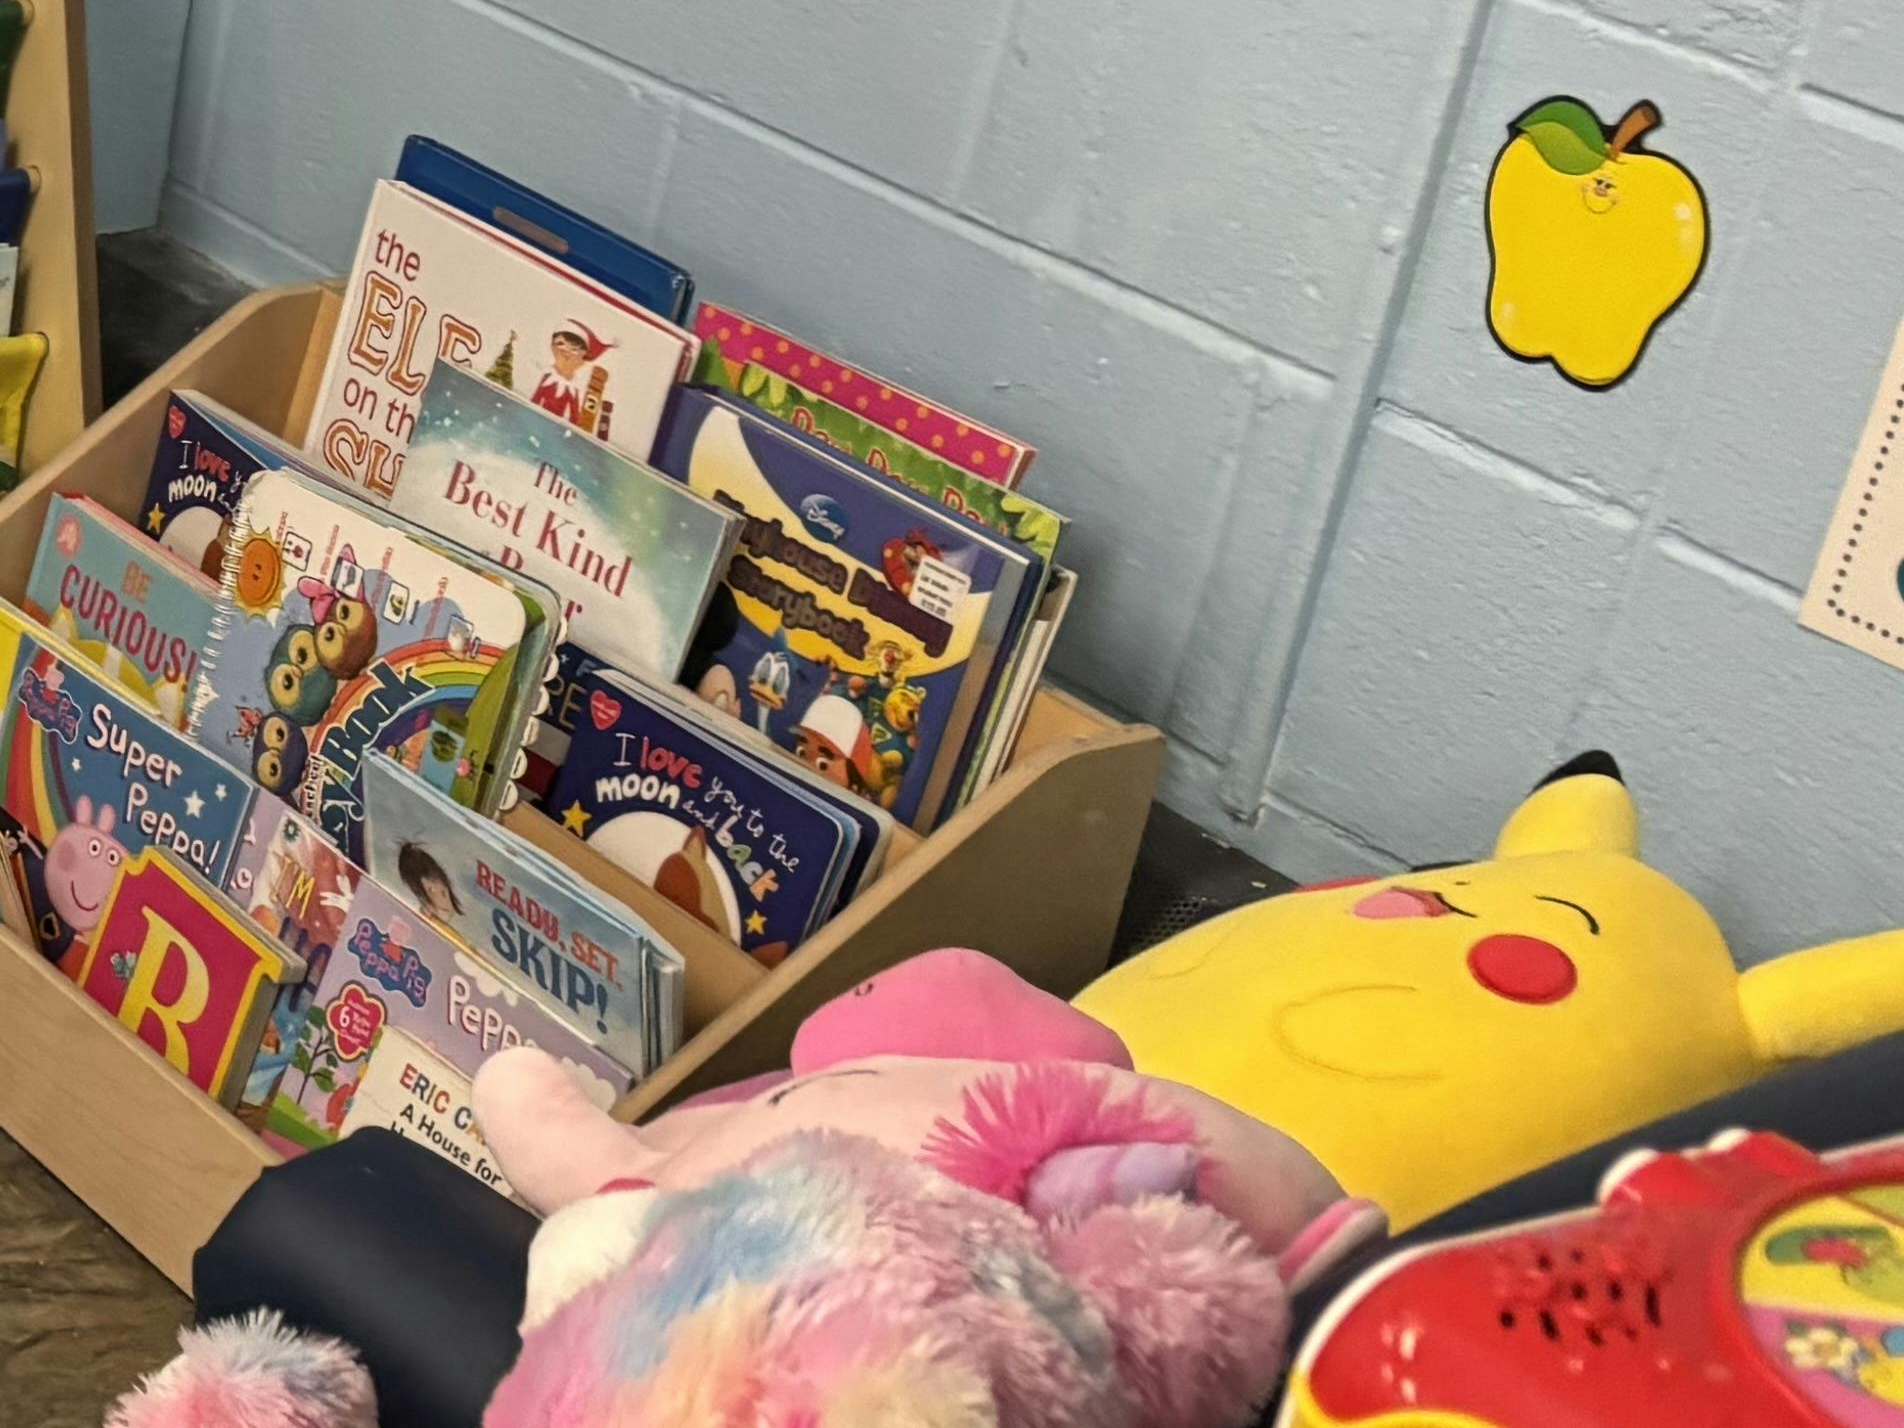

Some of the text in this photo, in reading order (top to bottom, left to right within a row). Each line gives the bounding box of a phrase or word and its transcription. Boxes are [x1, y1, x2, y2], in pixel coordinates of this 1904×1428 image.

[375, 228, 421, 282] the
[445, 460, 528, 537] Best
[536, 508, 633, 598] Kind
[534, 461, 577, 506] The
[60, 564, 198, 683] CURIOUS!
[121, 560, 152, 604] BE
[87, 703, 183, 788] Super
[614, 732, 799, 872] I love you to the
[596, 774, 779, 902] moon and back
[476, 859, 624, 991] READY, SET,
[490, 910, 609, 1035] SKIP!
[122, 904, 212, 1079] R
[399, 1063, 451, 1115] ERIC
[399, 1104, 503, 1188] A House for
